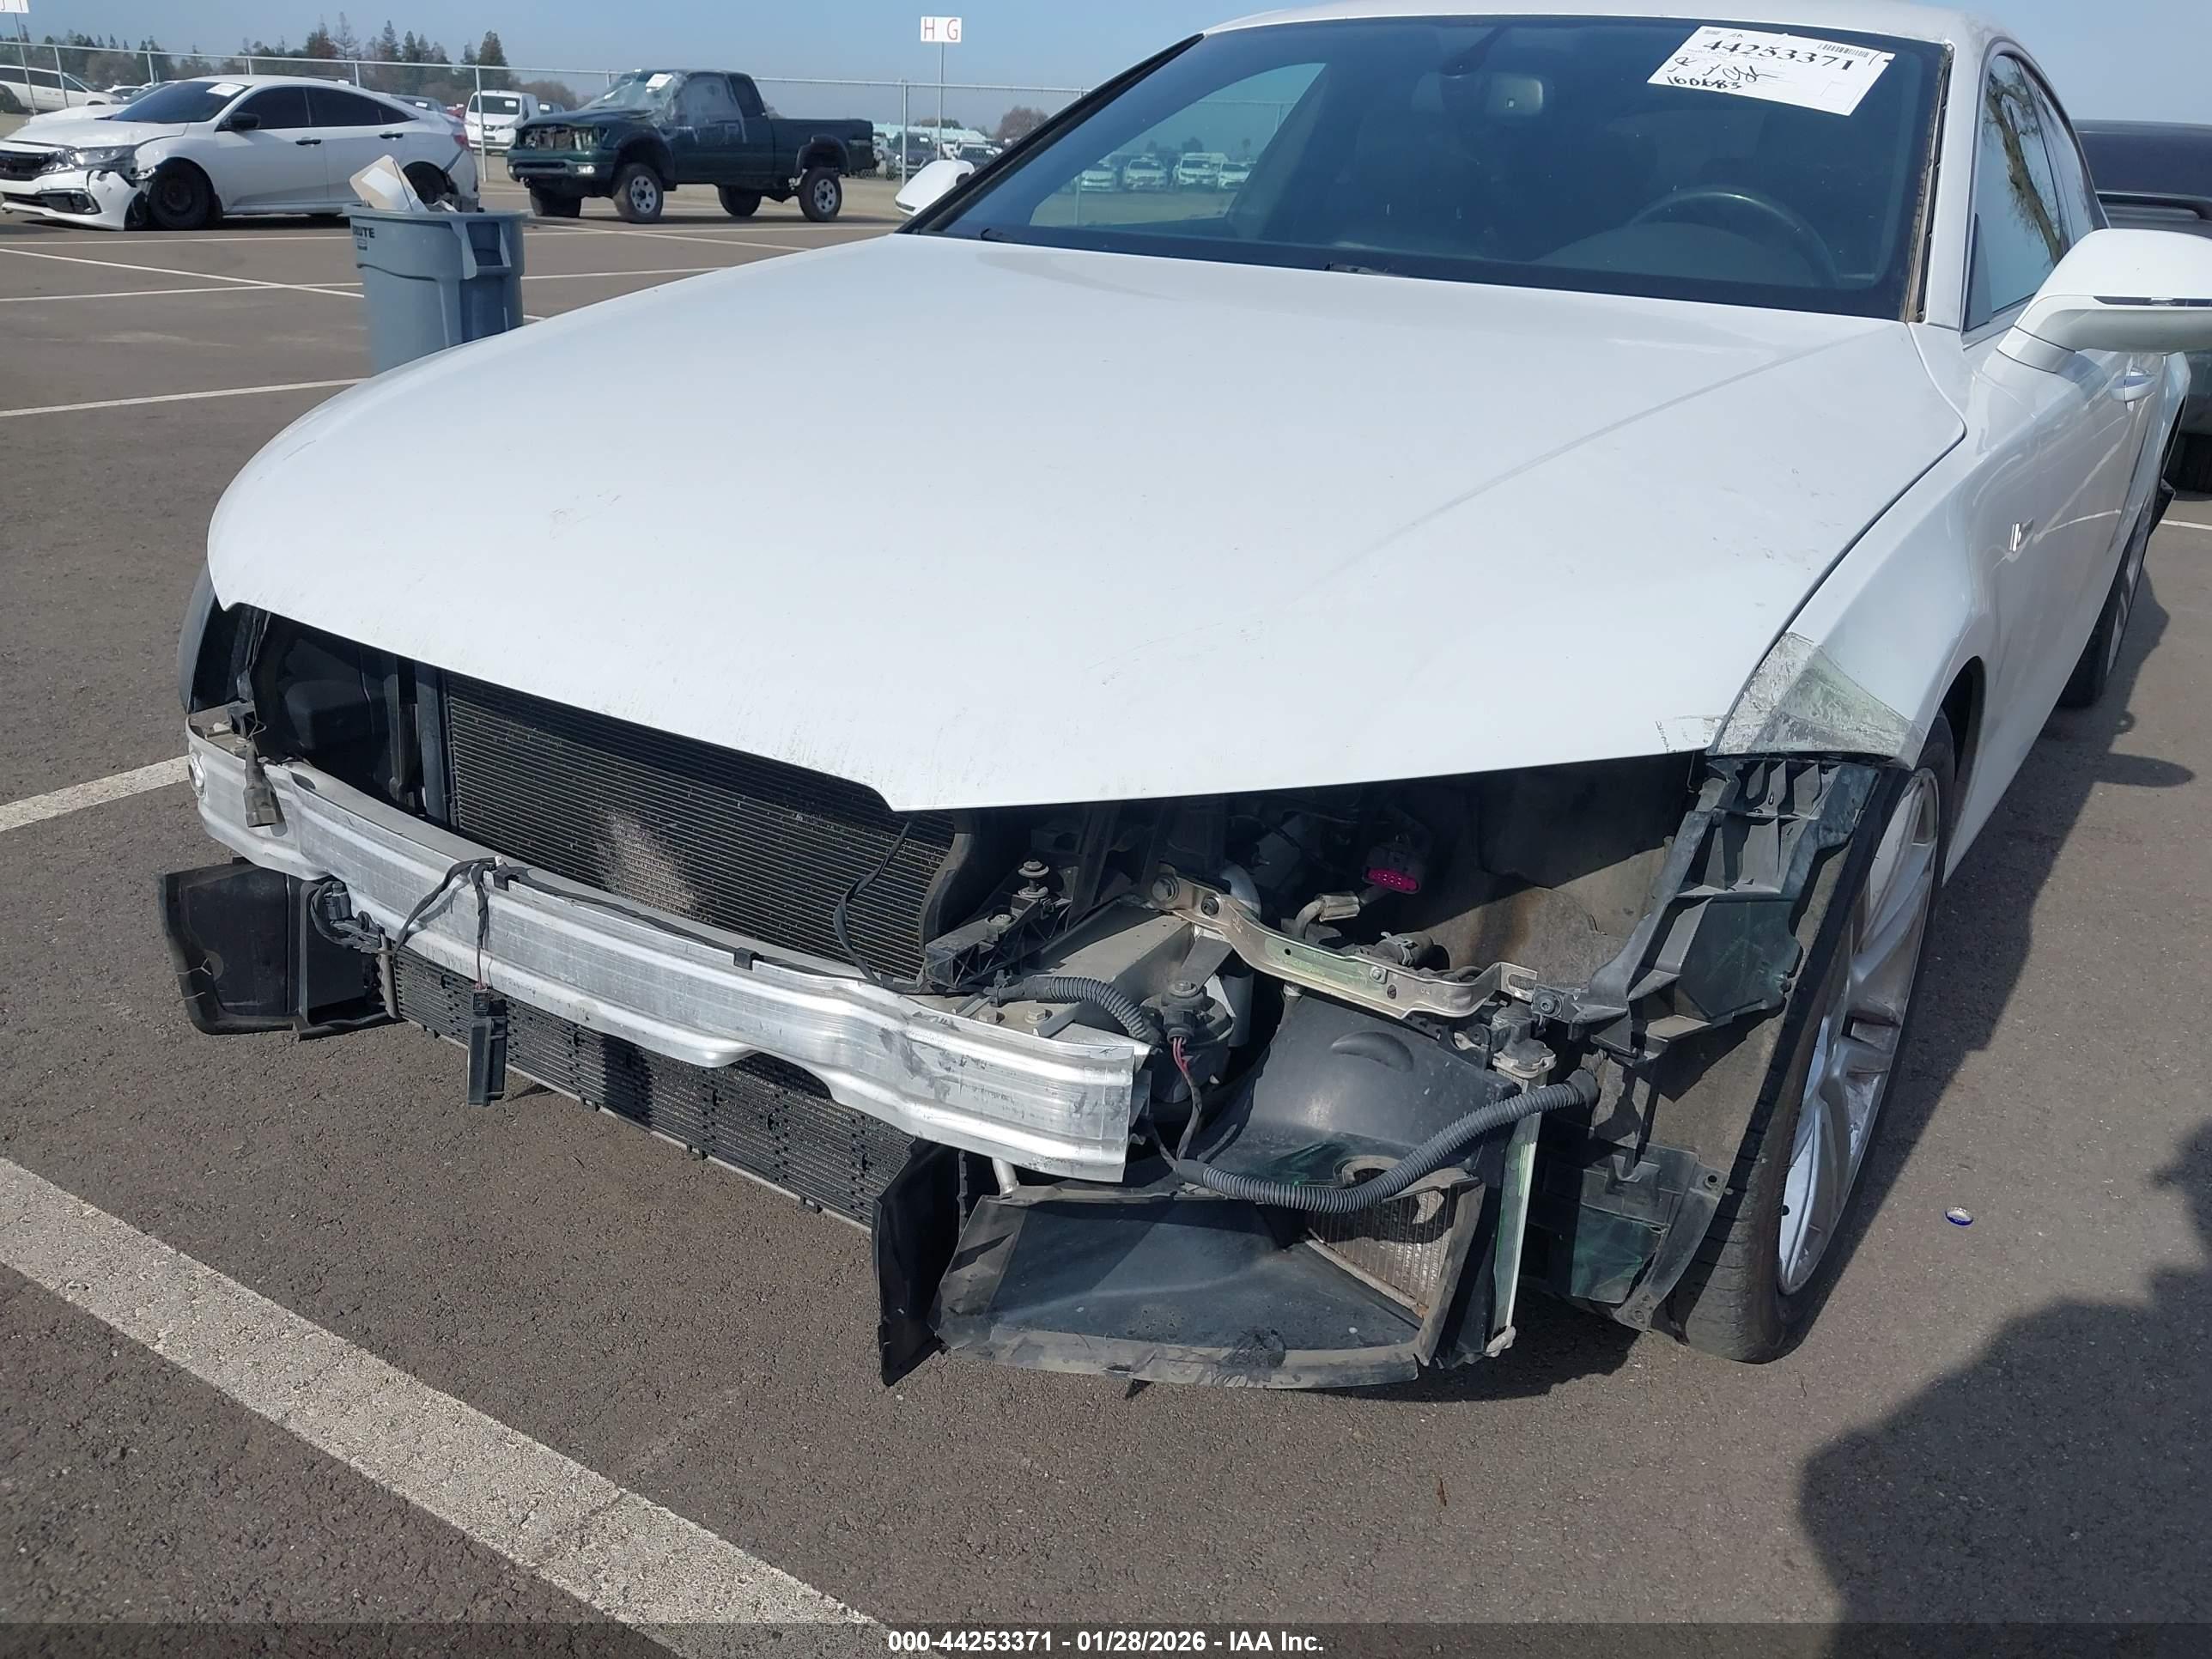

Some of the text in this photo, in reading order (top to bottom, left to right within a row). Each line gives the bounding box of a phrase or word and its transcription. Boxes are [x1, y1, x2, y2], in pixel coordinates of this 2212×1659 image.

[924, 18, 958, 40] H G
[1703, 40, 1855, 70] 44253371
